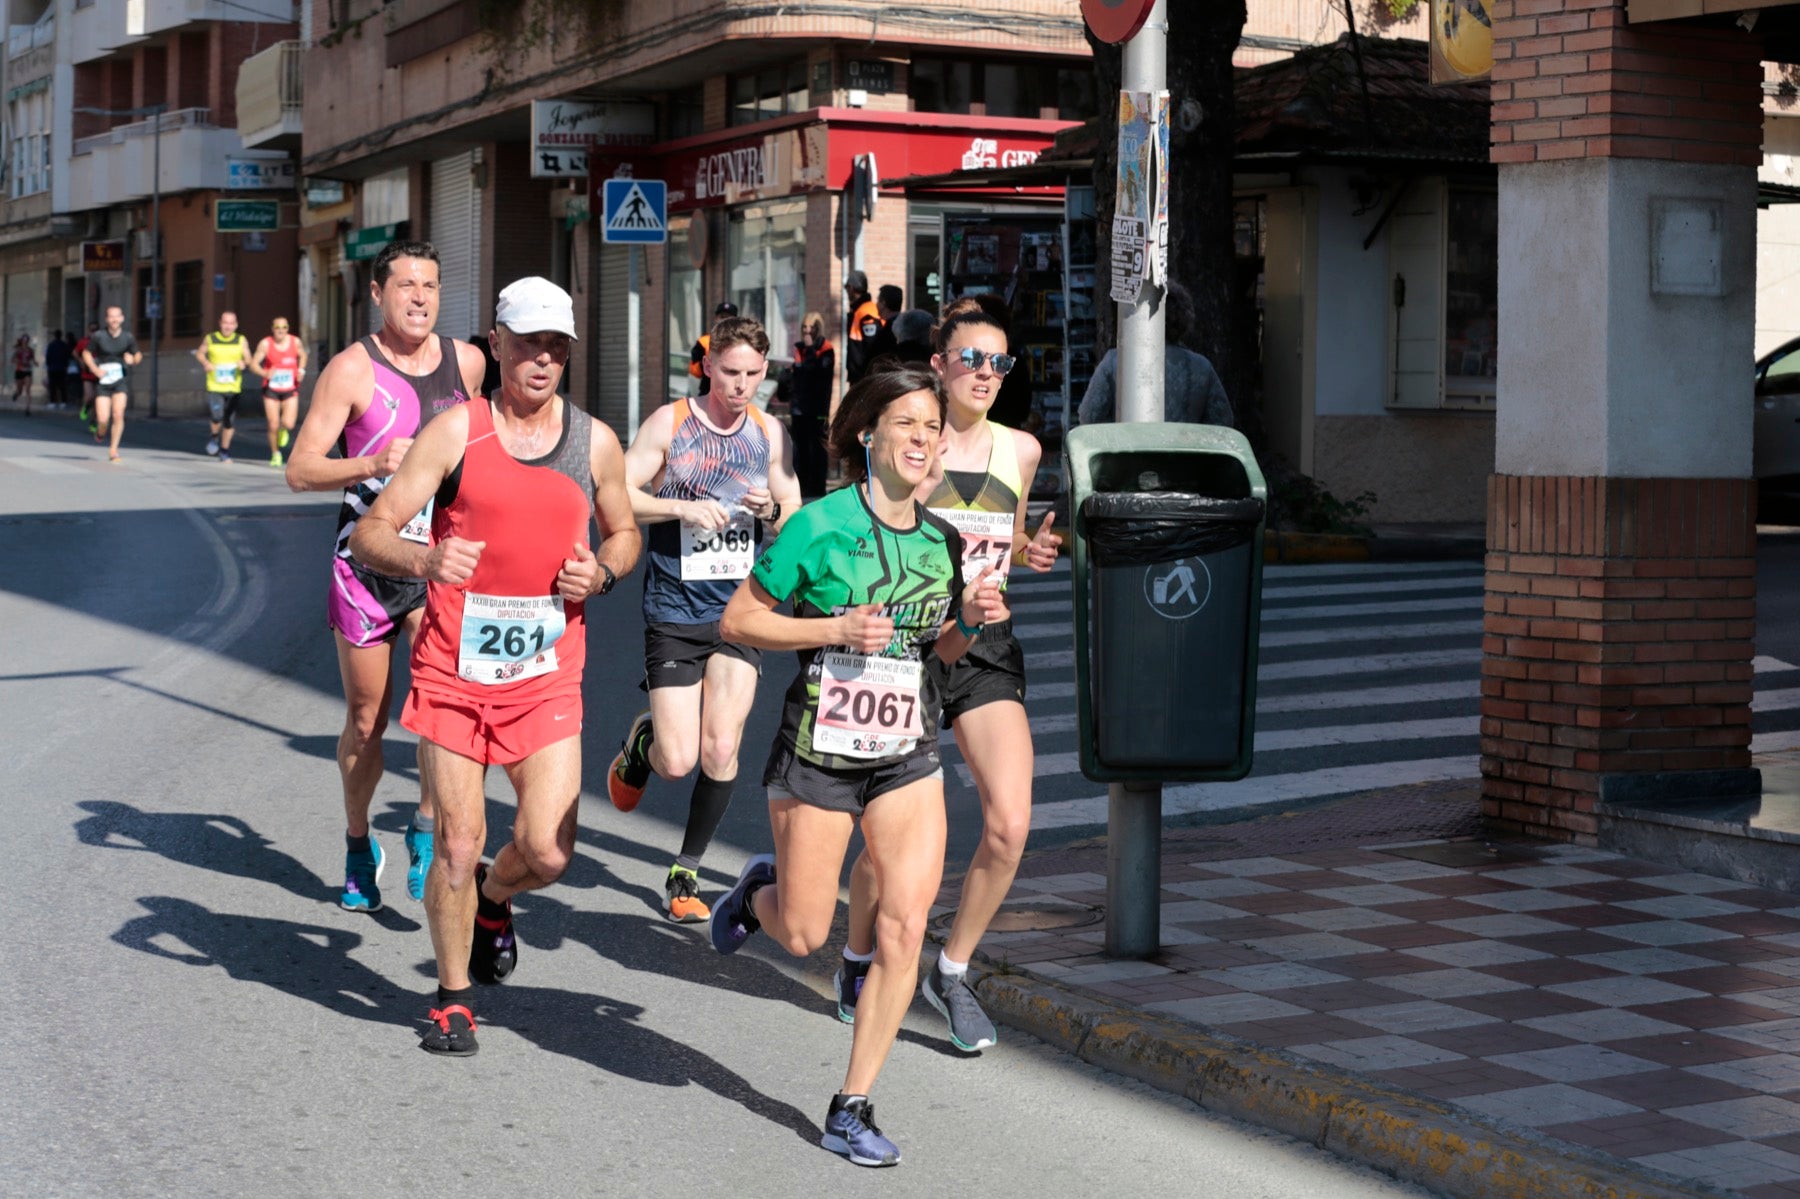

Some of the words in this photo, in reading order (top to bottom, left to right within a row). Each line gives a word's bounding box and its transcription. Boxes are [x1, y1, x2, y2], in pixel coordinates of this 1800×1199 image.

[707, 142, 780, 197] GENERALI
[1133, 252, 1143, 273] 9
[966, 513, 988, 523] PREMIO
[489, 598, 507, 608] GRAN
[508, 599, 532, 609] PREMIO
[532, 599, 540, 608] DE
[478, 624, 545, 657] 261
[852, 658, 872, 669] GRAN
[873, 661, 893, 672] PREMIO
[824, 686, 916, 729] 2067
